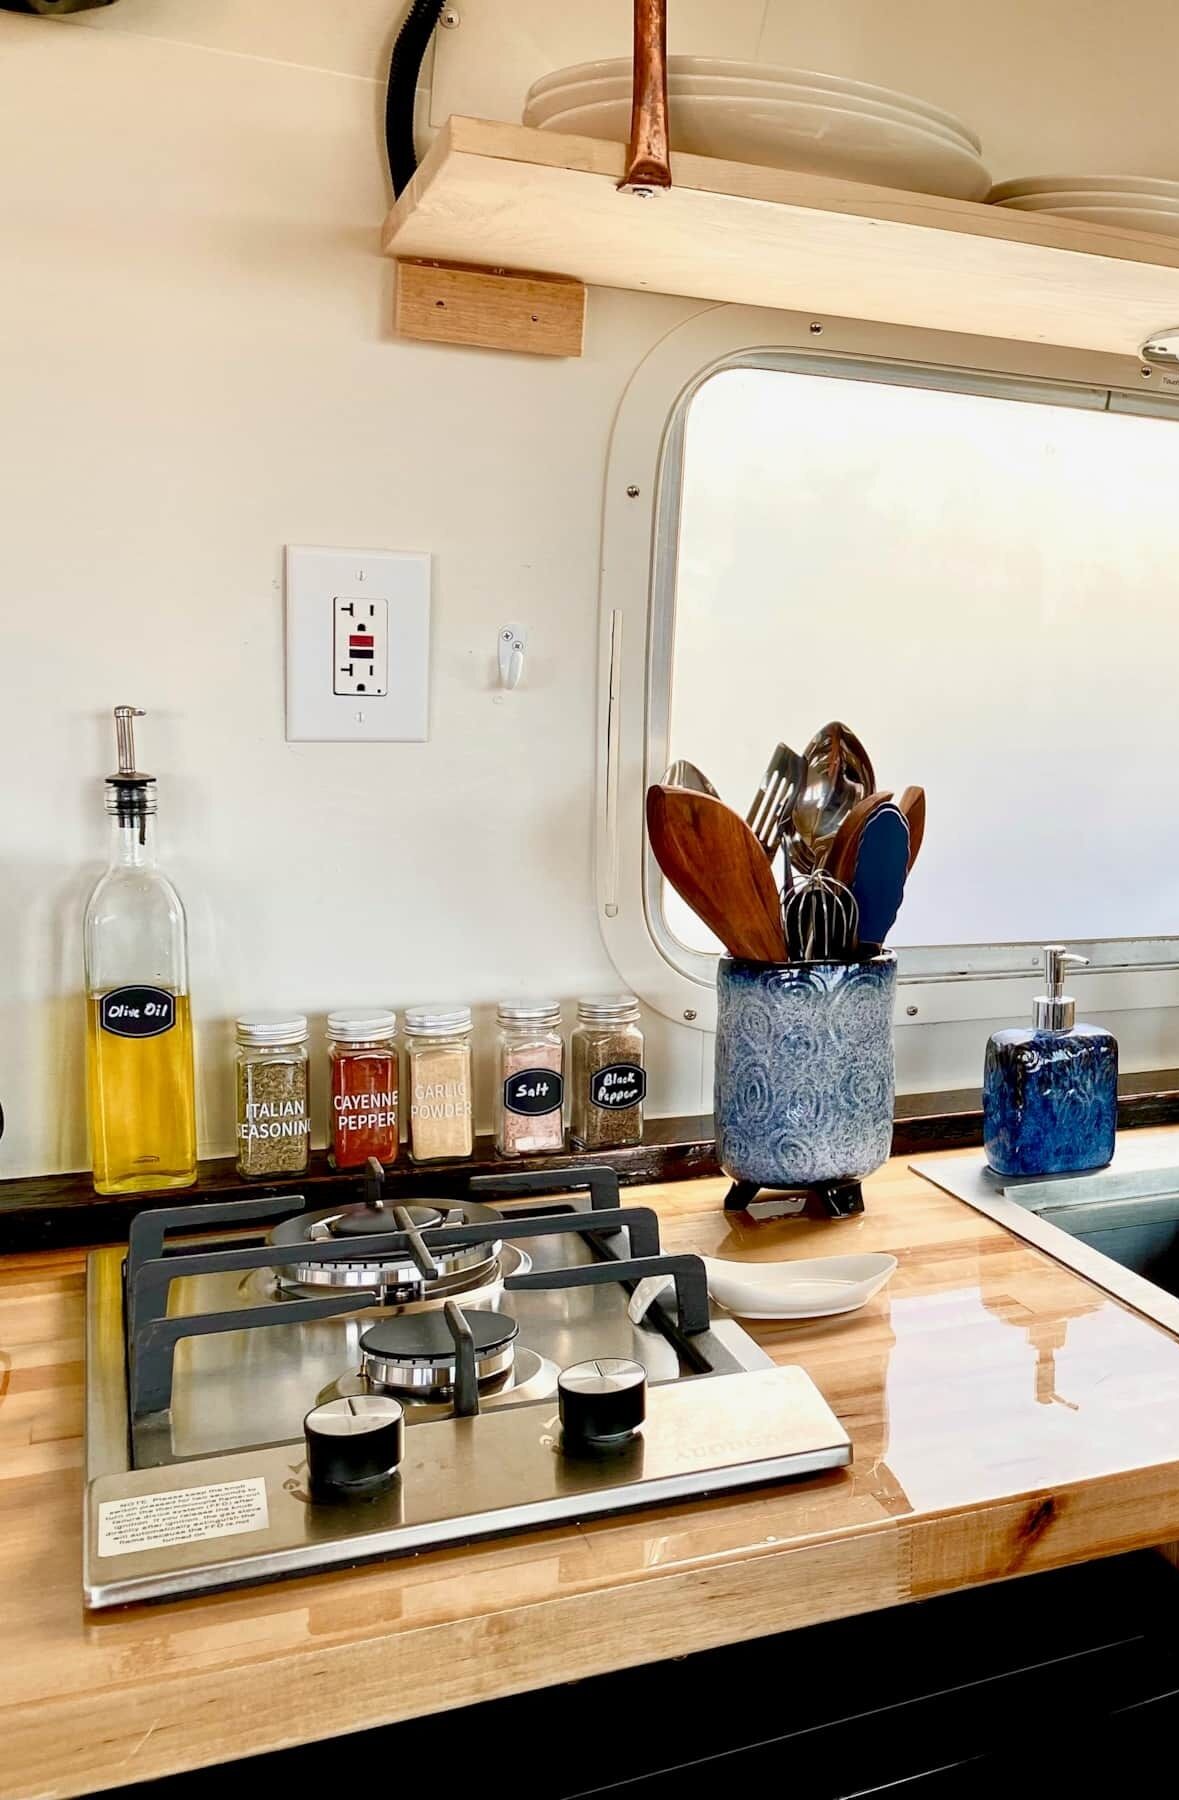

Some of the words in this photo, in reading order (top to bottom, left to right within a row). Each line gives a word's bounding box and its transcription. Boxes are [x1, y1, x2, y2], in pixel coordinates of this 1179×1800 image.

[1163, 377, 1179, 386] Touch
[108, 1004, 140, 1018] Olive
[144, 1002, 168, 1017] Oil
[603, 1072, 635, 1087] Black
[414, 1081, 466, 1100] GARLIC
[515, 1084, 550, 1098] Salt
[598, 1086, 638, 1103] Pepper
[246, 1100, 304, 1118] ITALIAN
[334, 1090, 398, 1111] CAYENNE
[411, 1102, 472, 1120] POWDER
[339, 1111, 396, 1130] PEPPER
